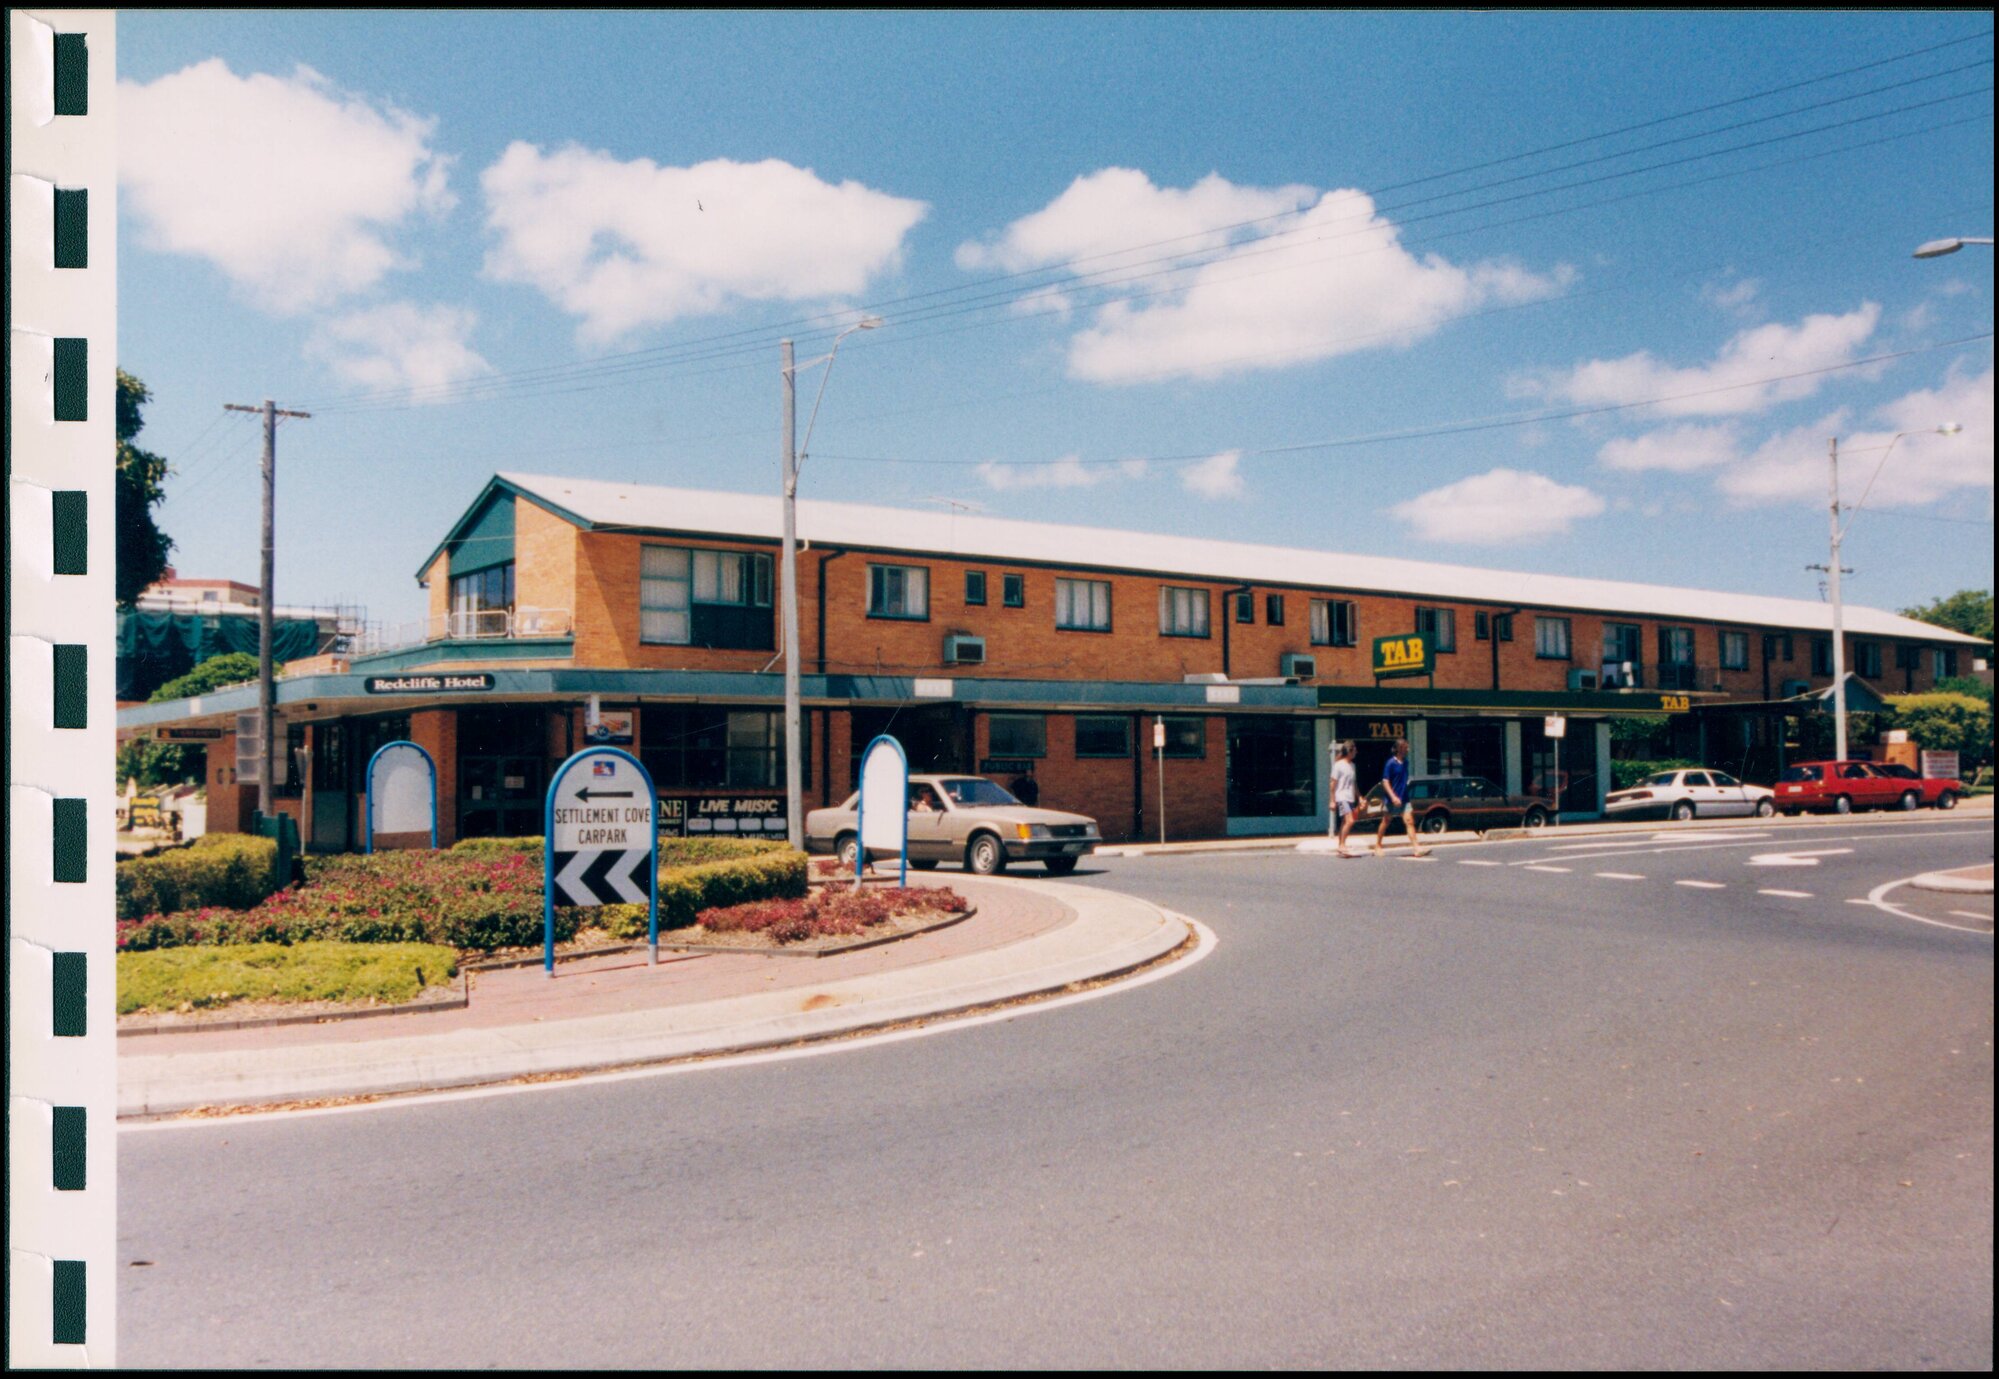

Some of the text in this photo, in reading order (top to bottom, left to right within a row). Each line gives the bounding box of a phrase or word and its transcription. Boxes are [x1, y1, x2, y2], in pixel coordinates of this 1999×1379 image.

[1381, 638, 1424, 666] TAB
[374, 676, 486, 690] Redcliffe Hotel
[1659, 696, 1690, 710] TAB
[1369, 723, 1404, 737] TAB
[698, 799, 779, 812] LIVE MUSIC
[555, 807, 651, 824] SETTLEMENT COVE
[578, 829, 627, 844] CARPARK
